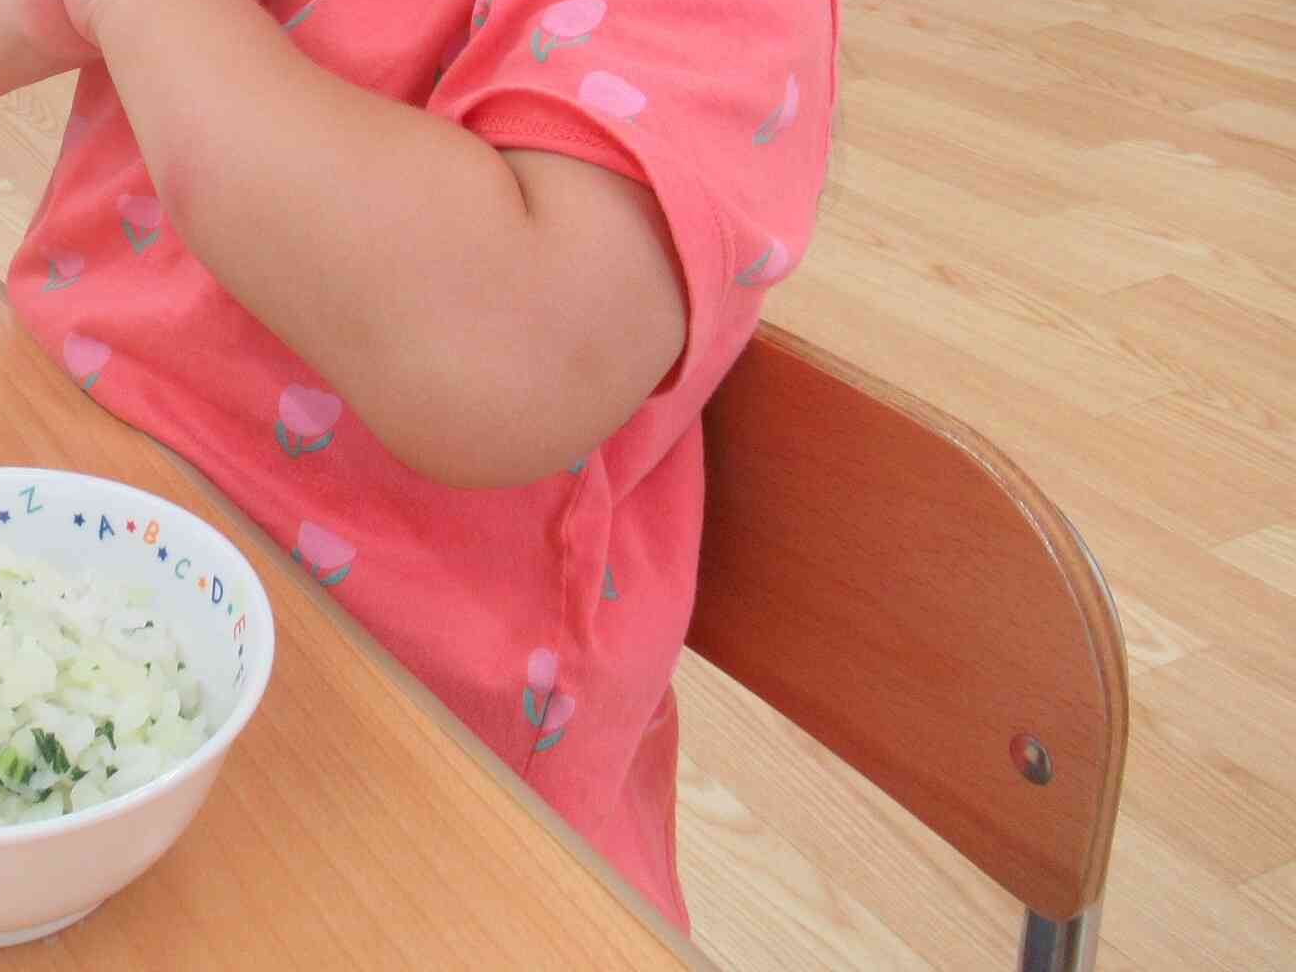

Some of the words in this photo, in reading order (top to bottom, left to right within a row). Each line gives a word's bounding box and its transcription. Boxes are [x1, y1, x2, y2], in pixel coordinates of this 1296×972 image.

[18, 485, 44, 514] Z
[98, 514, 115, 541] A
[143, 520, 160, 544] B
[175, 558, 192, 579] C
[211, 575, 224, 604] D
